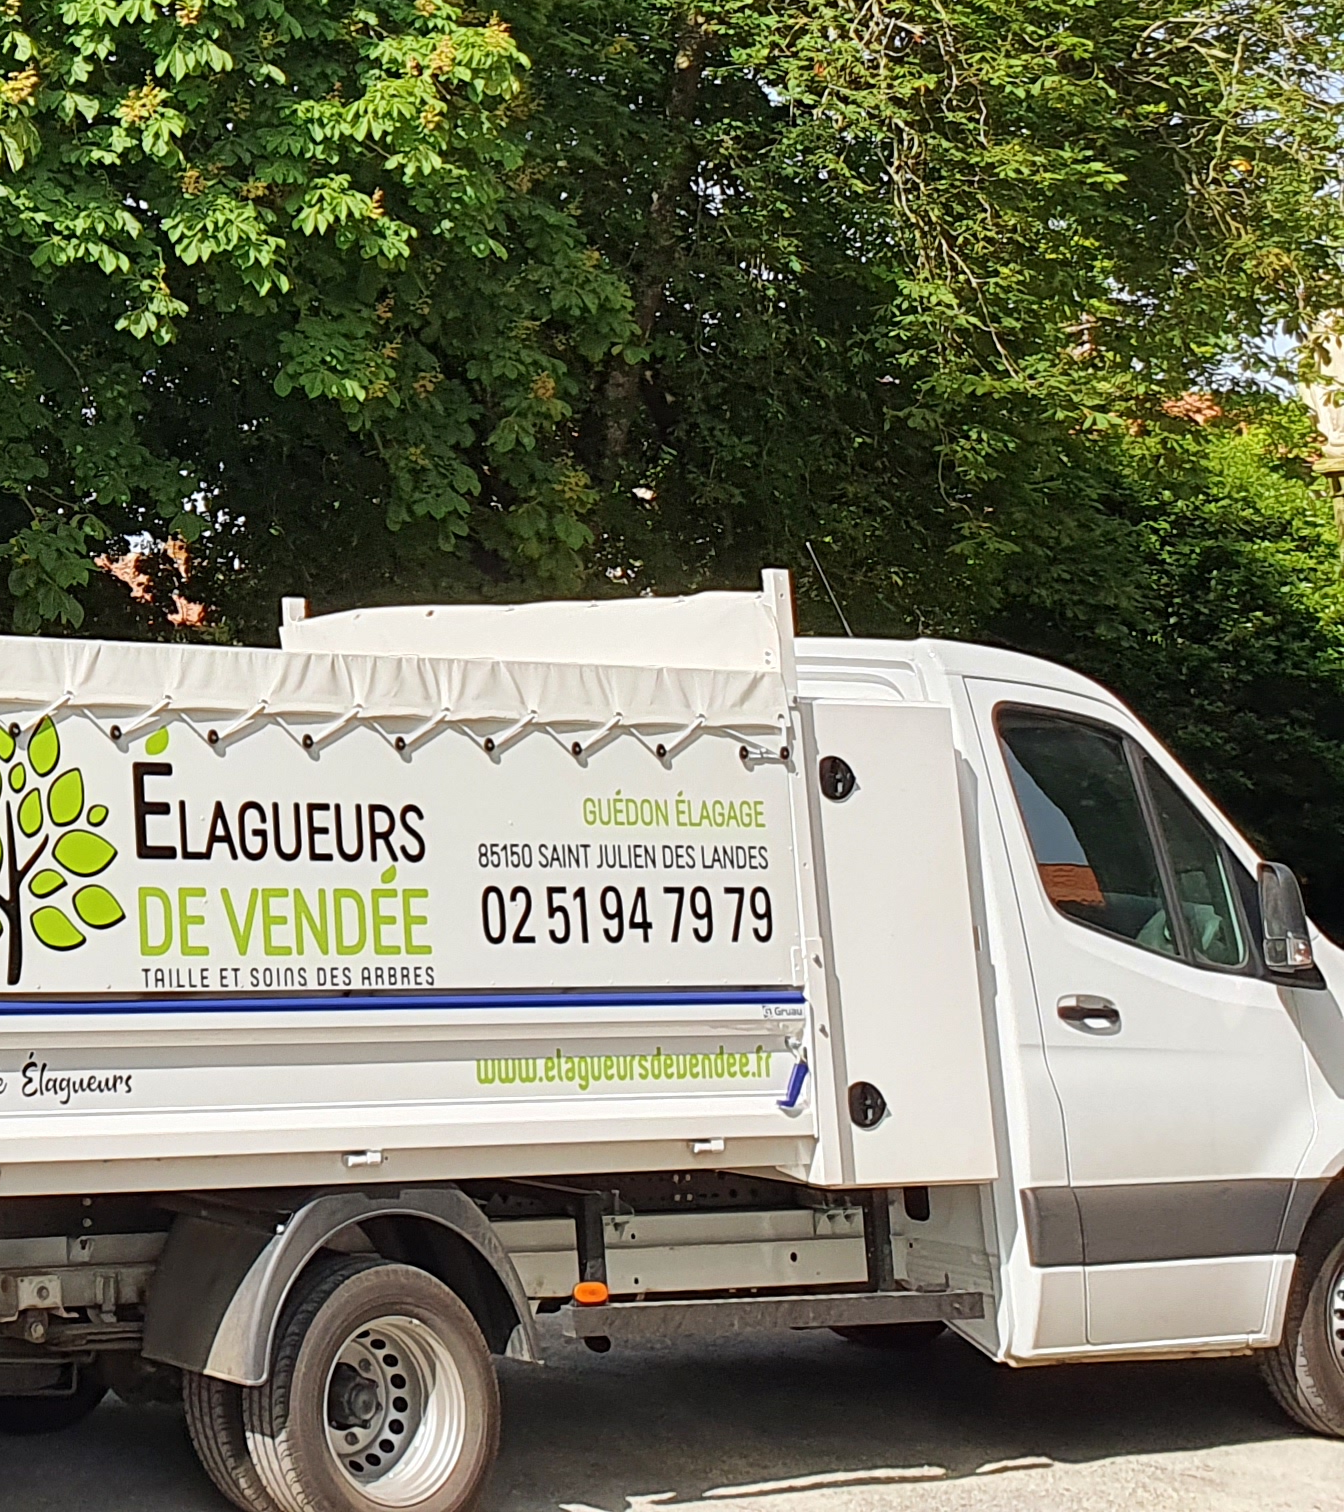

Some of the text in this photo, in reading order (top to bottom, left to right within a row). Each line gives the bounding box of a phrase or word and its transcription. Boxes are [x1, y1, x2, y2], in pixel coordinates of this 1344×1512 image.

[132, 725, 426, 863] ÉLAGUEURS
[582, 789, 767, 829] GUÉDON ÉLAGAGE
[477, 843, 770, 870] 85150 SAINT JULIEN DES LANDES
[138, 864, 433, 957] DE VENDÉE
[481, 885, 774, 945] 02 51 94 79 79
[141, 966, 435, 988] TAILLE ET SOINS DES ARBRES
[773, 1005, 804, 1017] Gruau
[21, 1051, 133, 1106] Élagueurs
[475, 1044, 772, 1092] www.elagueursdevendee.fr
